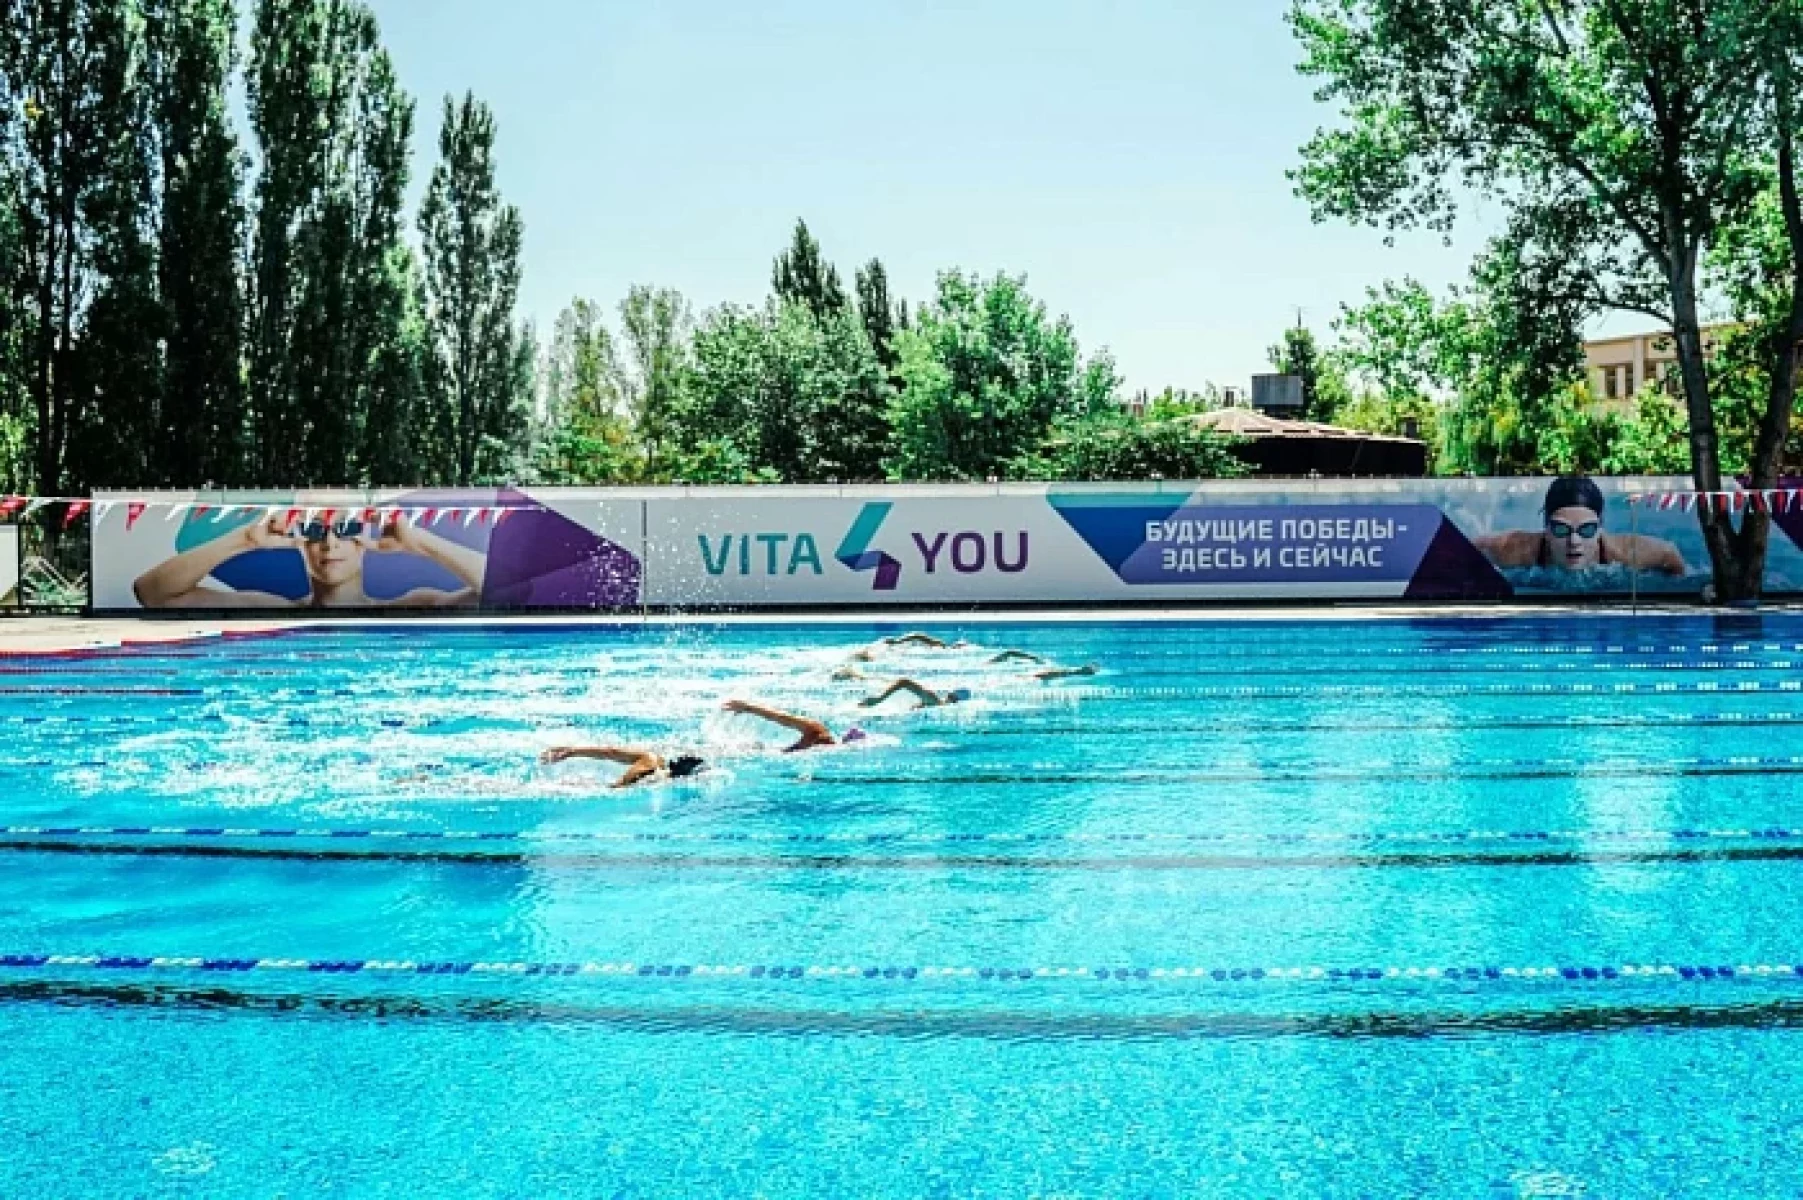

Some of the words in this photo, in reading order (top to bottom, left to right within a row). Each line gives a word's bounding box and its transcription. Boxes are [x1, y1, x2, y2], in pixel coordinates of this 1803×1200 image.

[1145, 519, 1273, 543] БУДУЩИЕ
[698, 533, 823, 575] VITA
[911, 531, 1029, 574] YOU
[1162, 547, 1246, 572] ЗДЕСЬ
[1254, 547, 1271, 569] И
[1279, 542, 1383, 568] СЕЙЧАС
